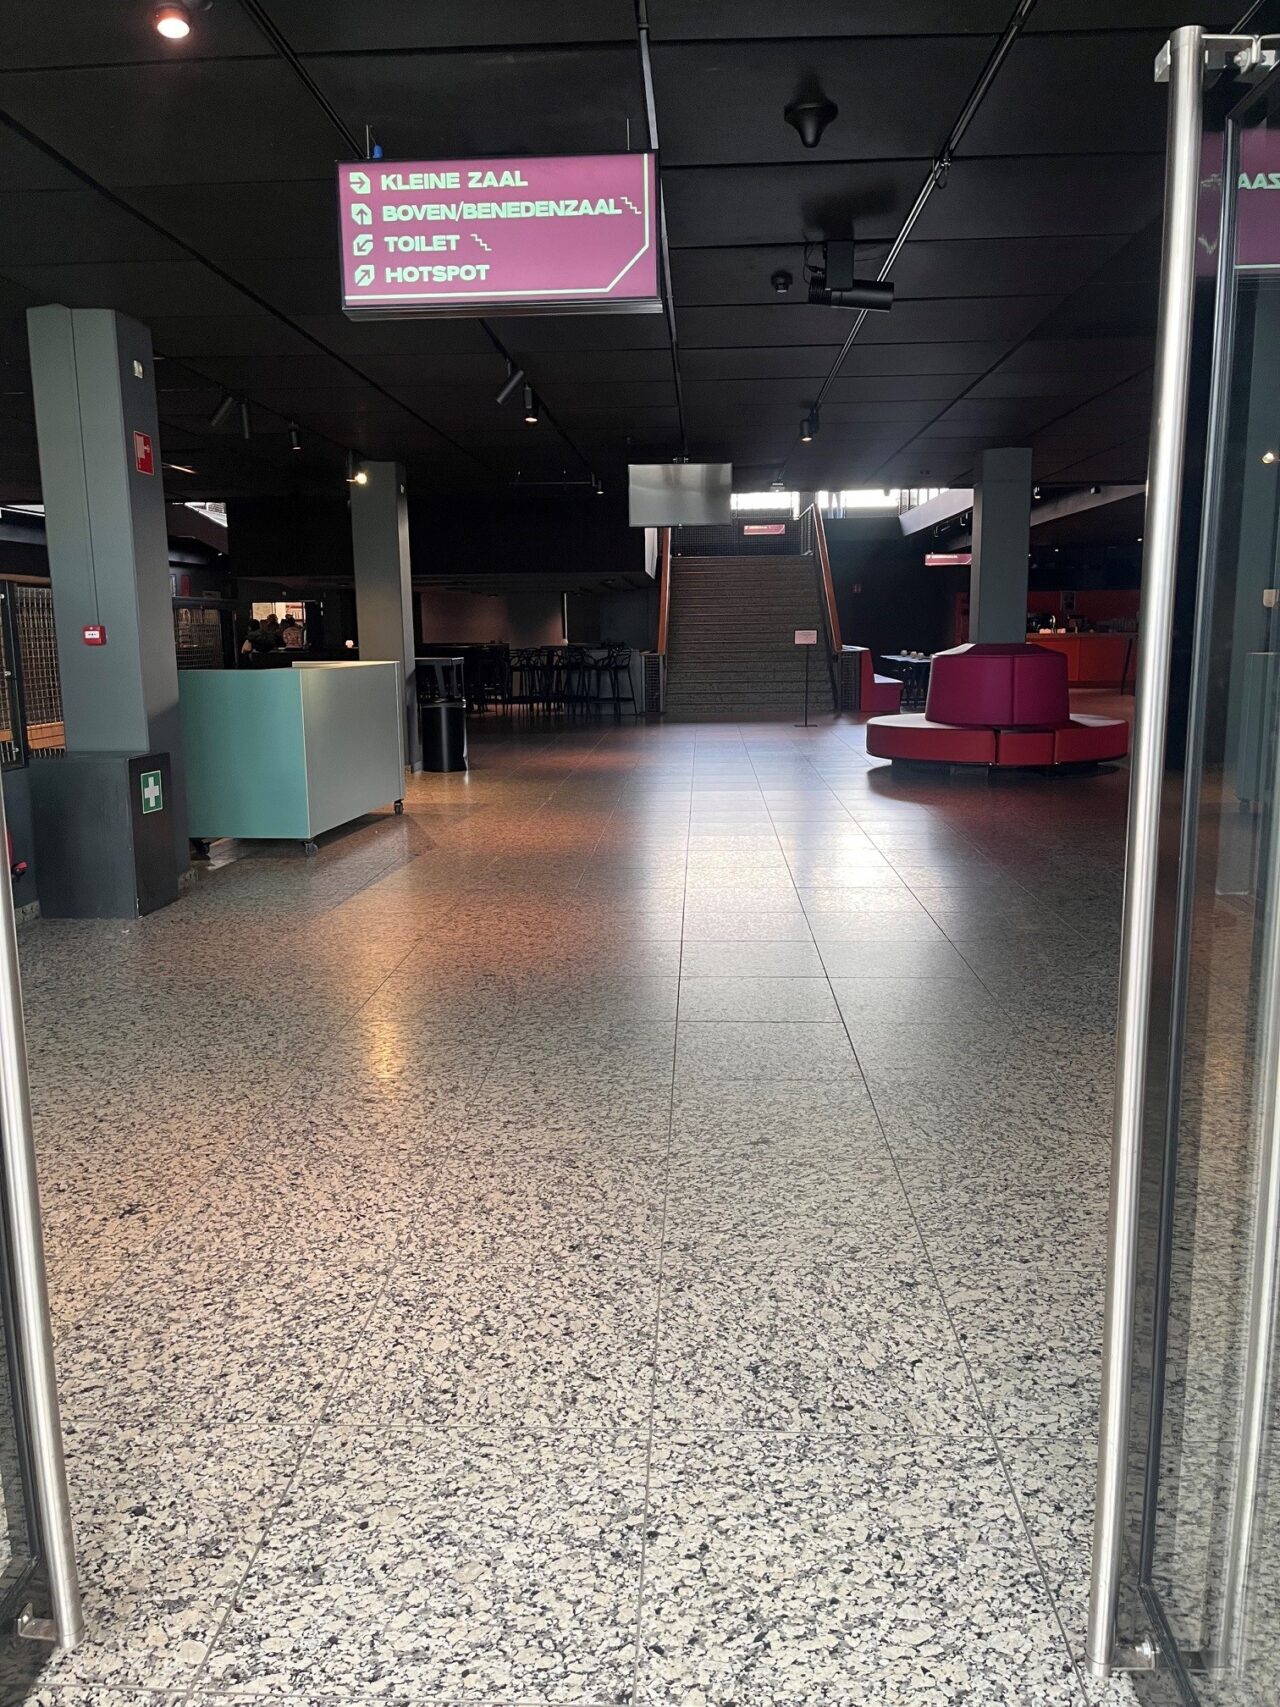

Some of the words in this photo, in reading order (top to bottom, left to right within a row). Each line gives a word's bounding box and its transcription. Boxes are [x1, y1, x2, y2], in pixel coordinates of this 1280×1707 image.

[381, 173, 460, 190] KLEINE
[467, 171, 528, 188] ZAAL
[382, 199, 622, 221] BOVEN/BENEDENZAAL
[384, 234, 460, 252] TOILET
[385, 264, 490, 282] HOTSPOT
